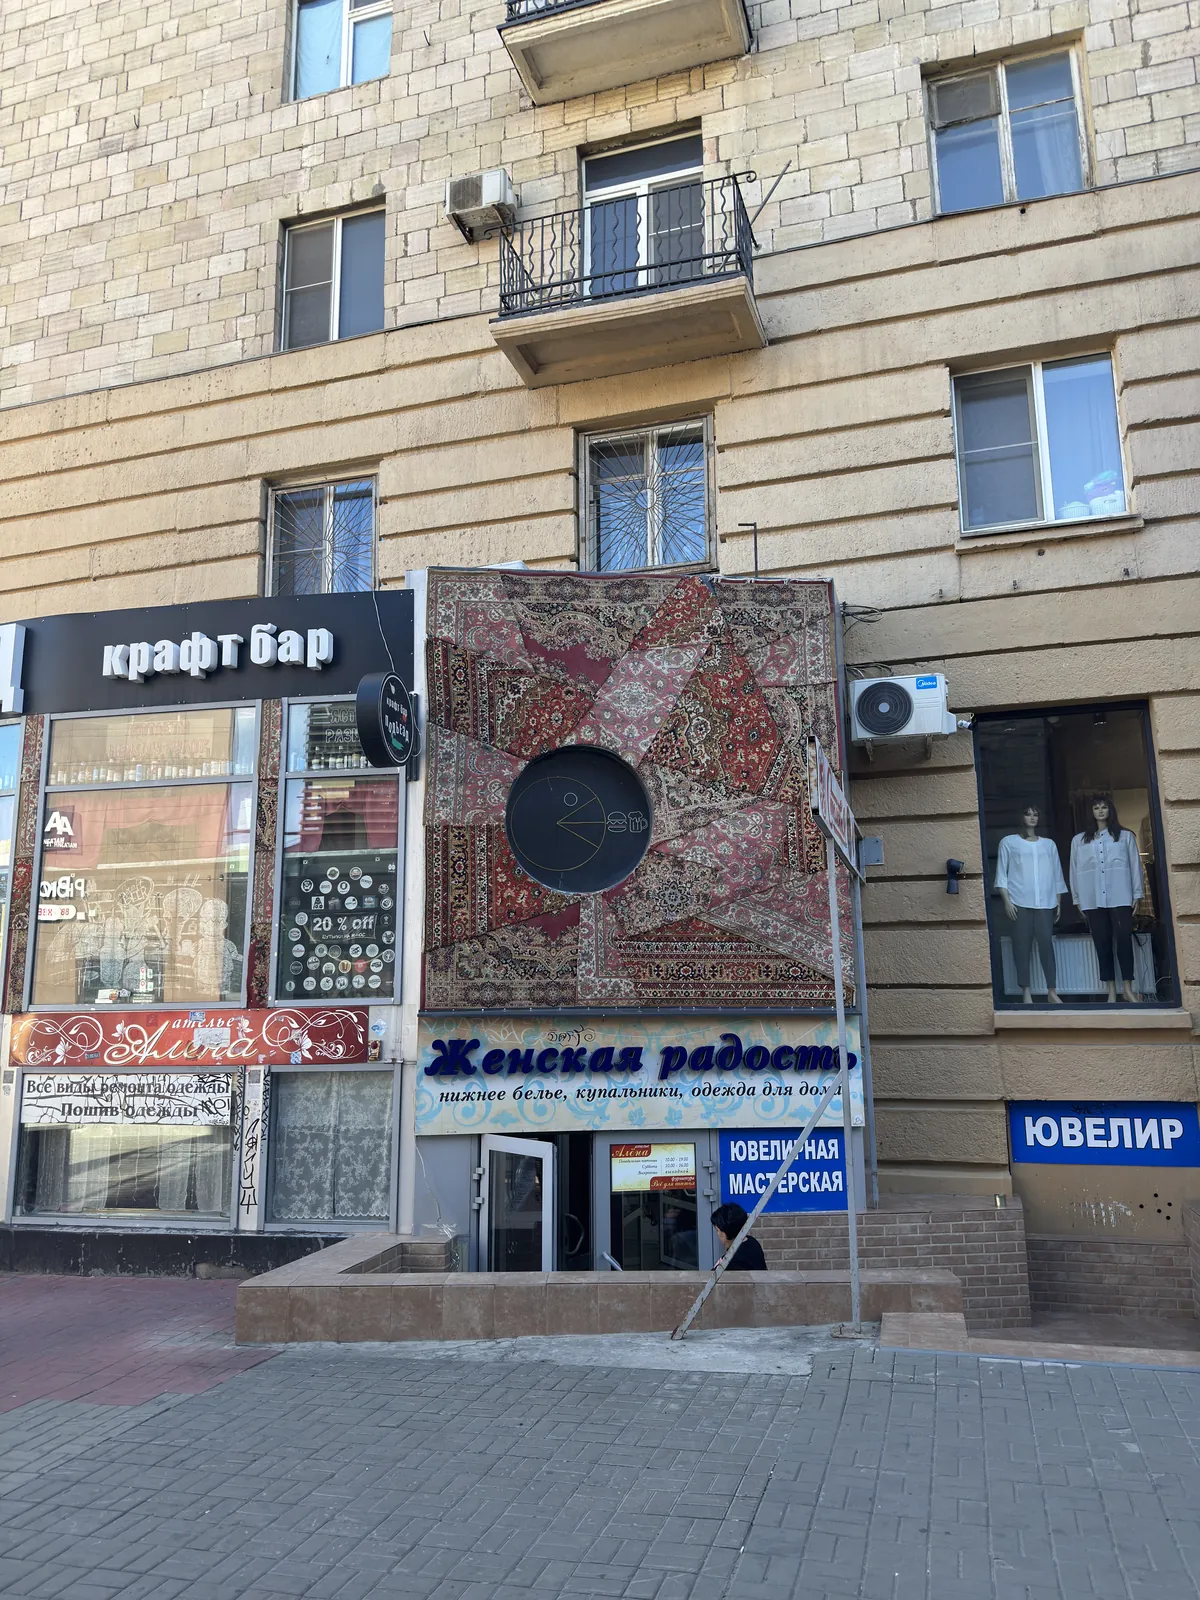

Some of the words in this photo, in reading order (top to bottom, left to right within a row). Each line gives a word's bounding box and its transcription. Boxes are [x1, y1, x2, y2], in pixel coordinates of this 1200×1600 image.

[102, 631, 244, 684] крафт
[249, 622, 334, 671] бар
[312, 916, 333, 931] 20
[337, 916, 348, 931] %
[352, 914, 375, 930] off
[171, 1015, 235, 1030] ателье
[423, 1038, 644, 1077] Женская
[658, 1032, 858, 1080] радость
[26, 1080, 52, 1094] Все
[56, 1081, 95, 1096] виды
[100, 1083, 162, 1096] ремонта
[167, 1081, 230, 1097] одежды
[439, 1089, 506, 1102] нижнее
[512, 1085, 567, 1101] белье,
[576, 1086, 683, 1103] купальники,
[691, 1082, 756, 1097] одежда
[762, 1081, 793, 1096] для
[60, 1103, 125, 1117] Пошив
[126, 1103, 198, 1119] одежды
[1024, 1116, 1184, 1149] ЮВЕЛИР
[612, 1144, 649, 1157] Алёна
